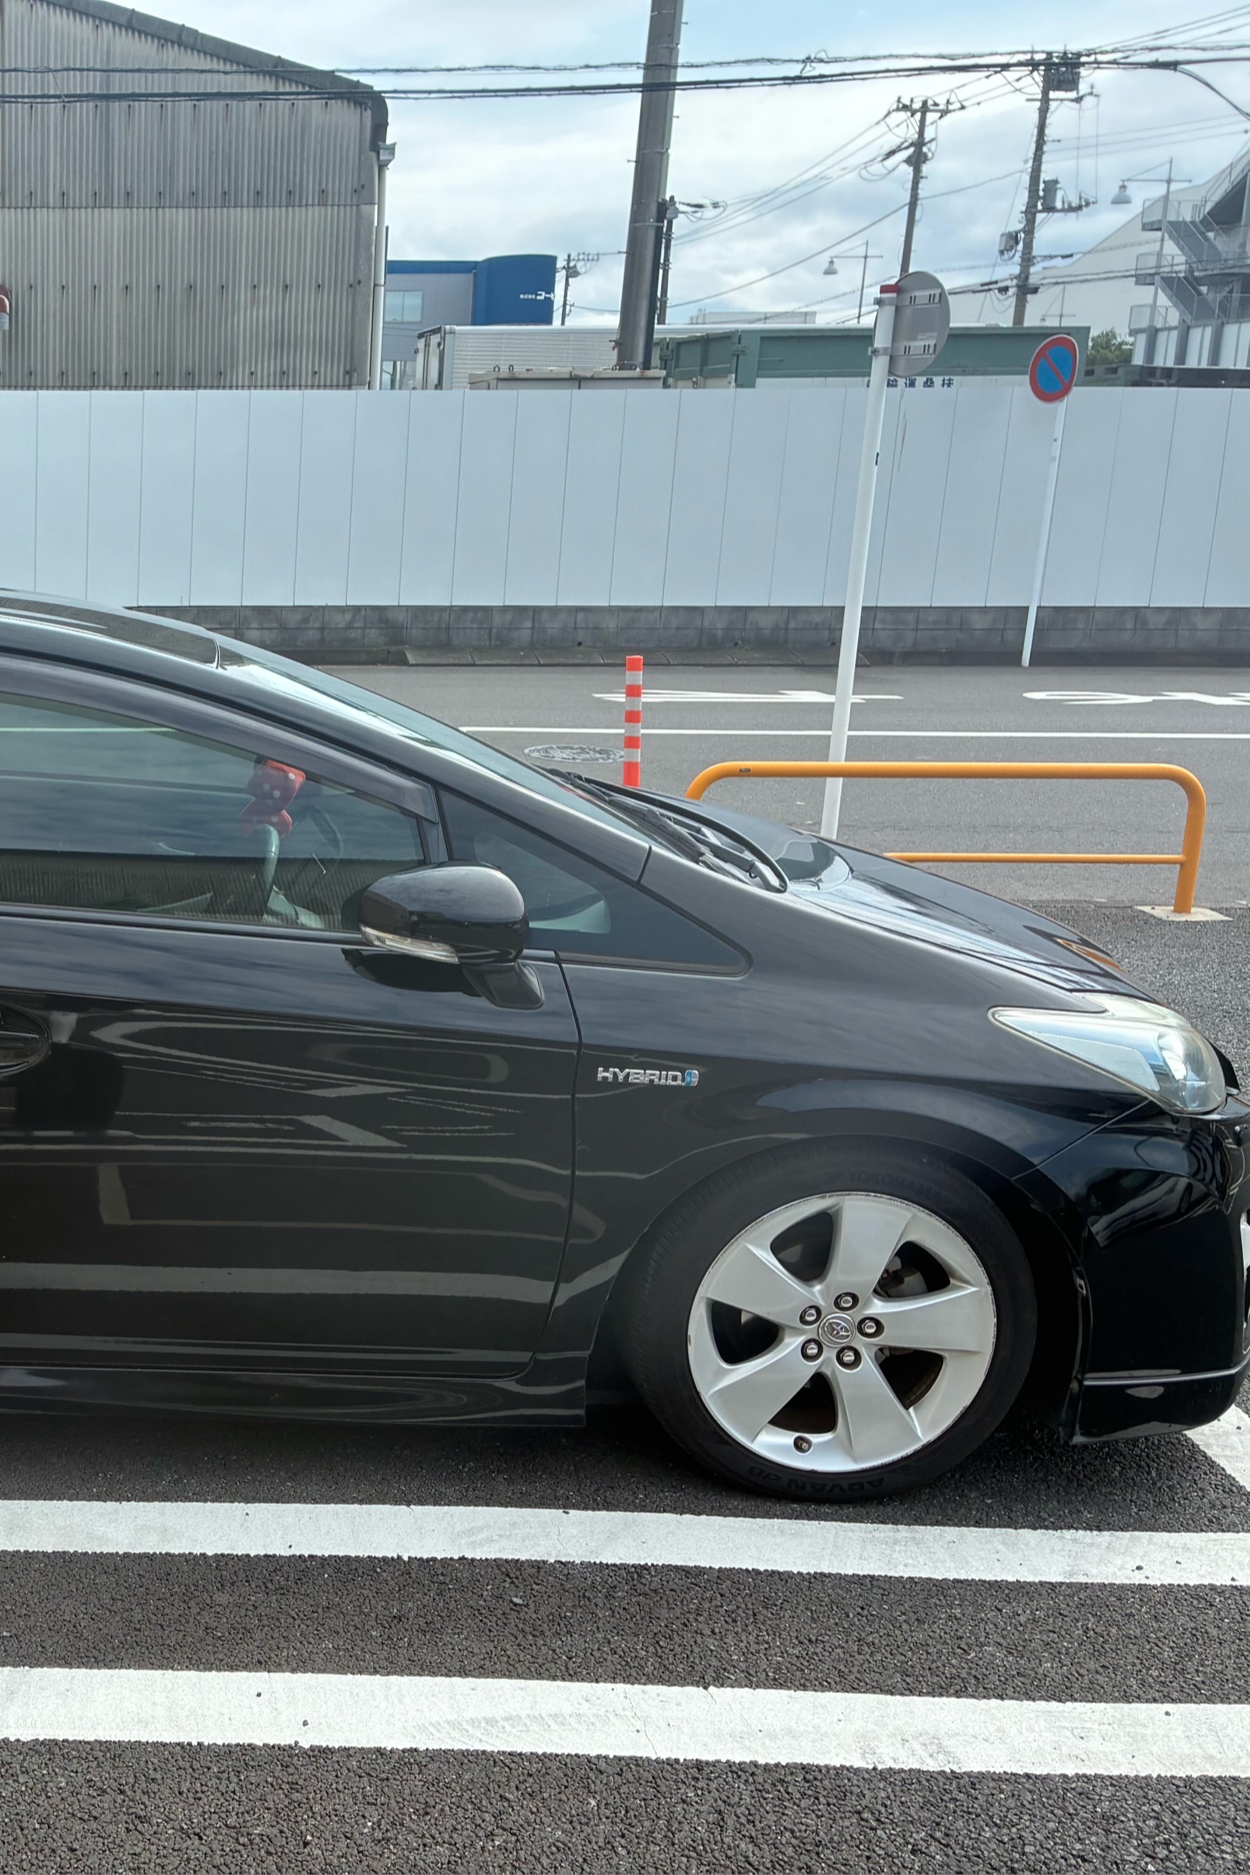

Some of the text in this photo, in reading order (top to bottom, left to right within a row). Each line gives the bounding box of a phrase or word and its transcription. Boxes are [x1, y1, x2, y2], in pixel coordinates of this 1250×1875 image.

[596, 1067, 683, 1086] HYBRID
[848, 1170, 942, 1202] YOKOHAMA
[785, 1476, 886, 1494] ADVAN
